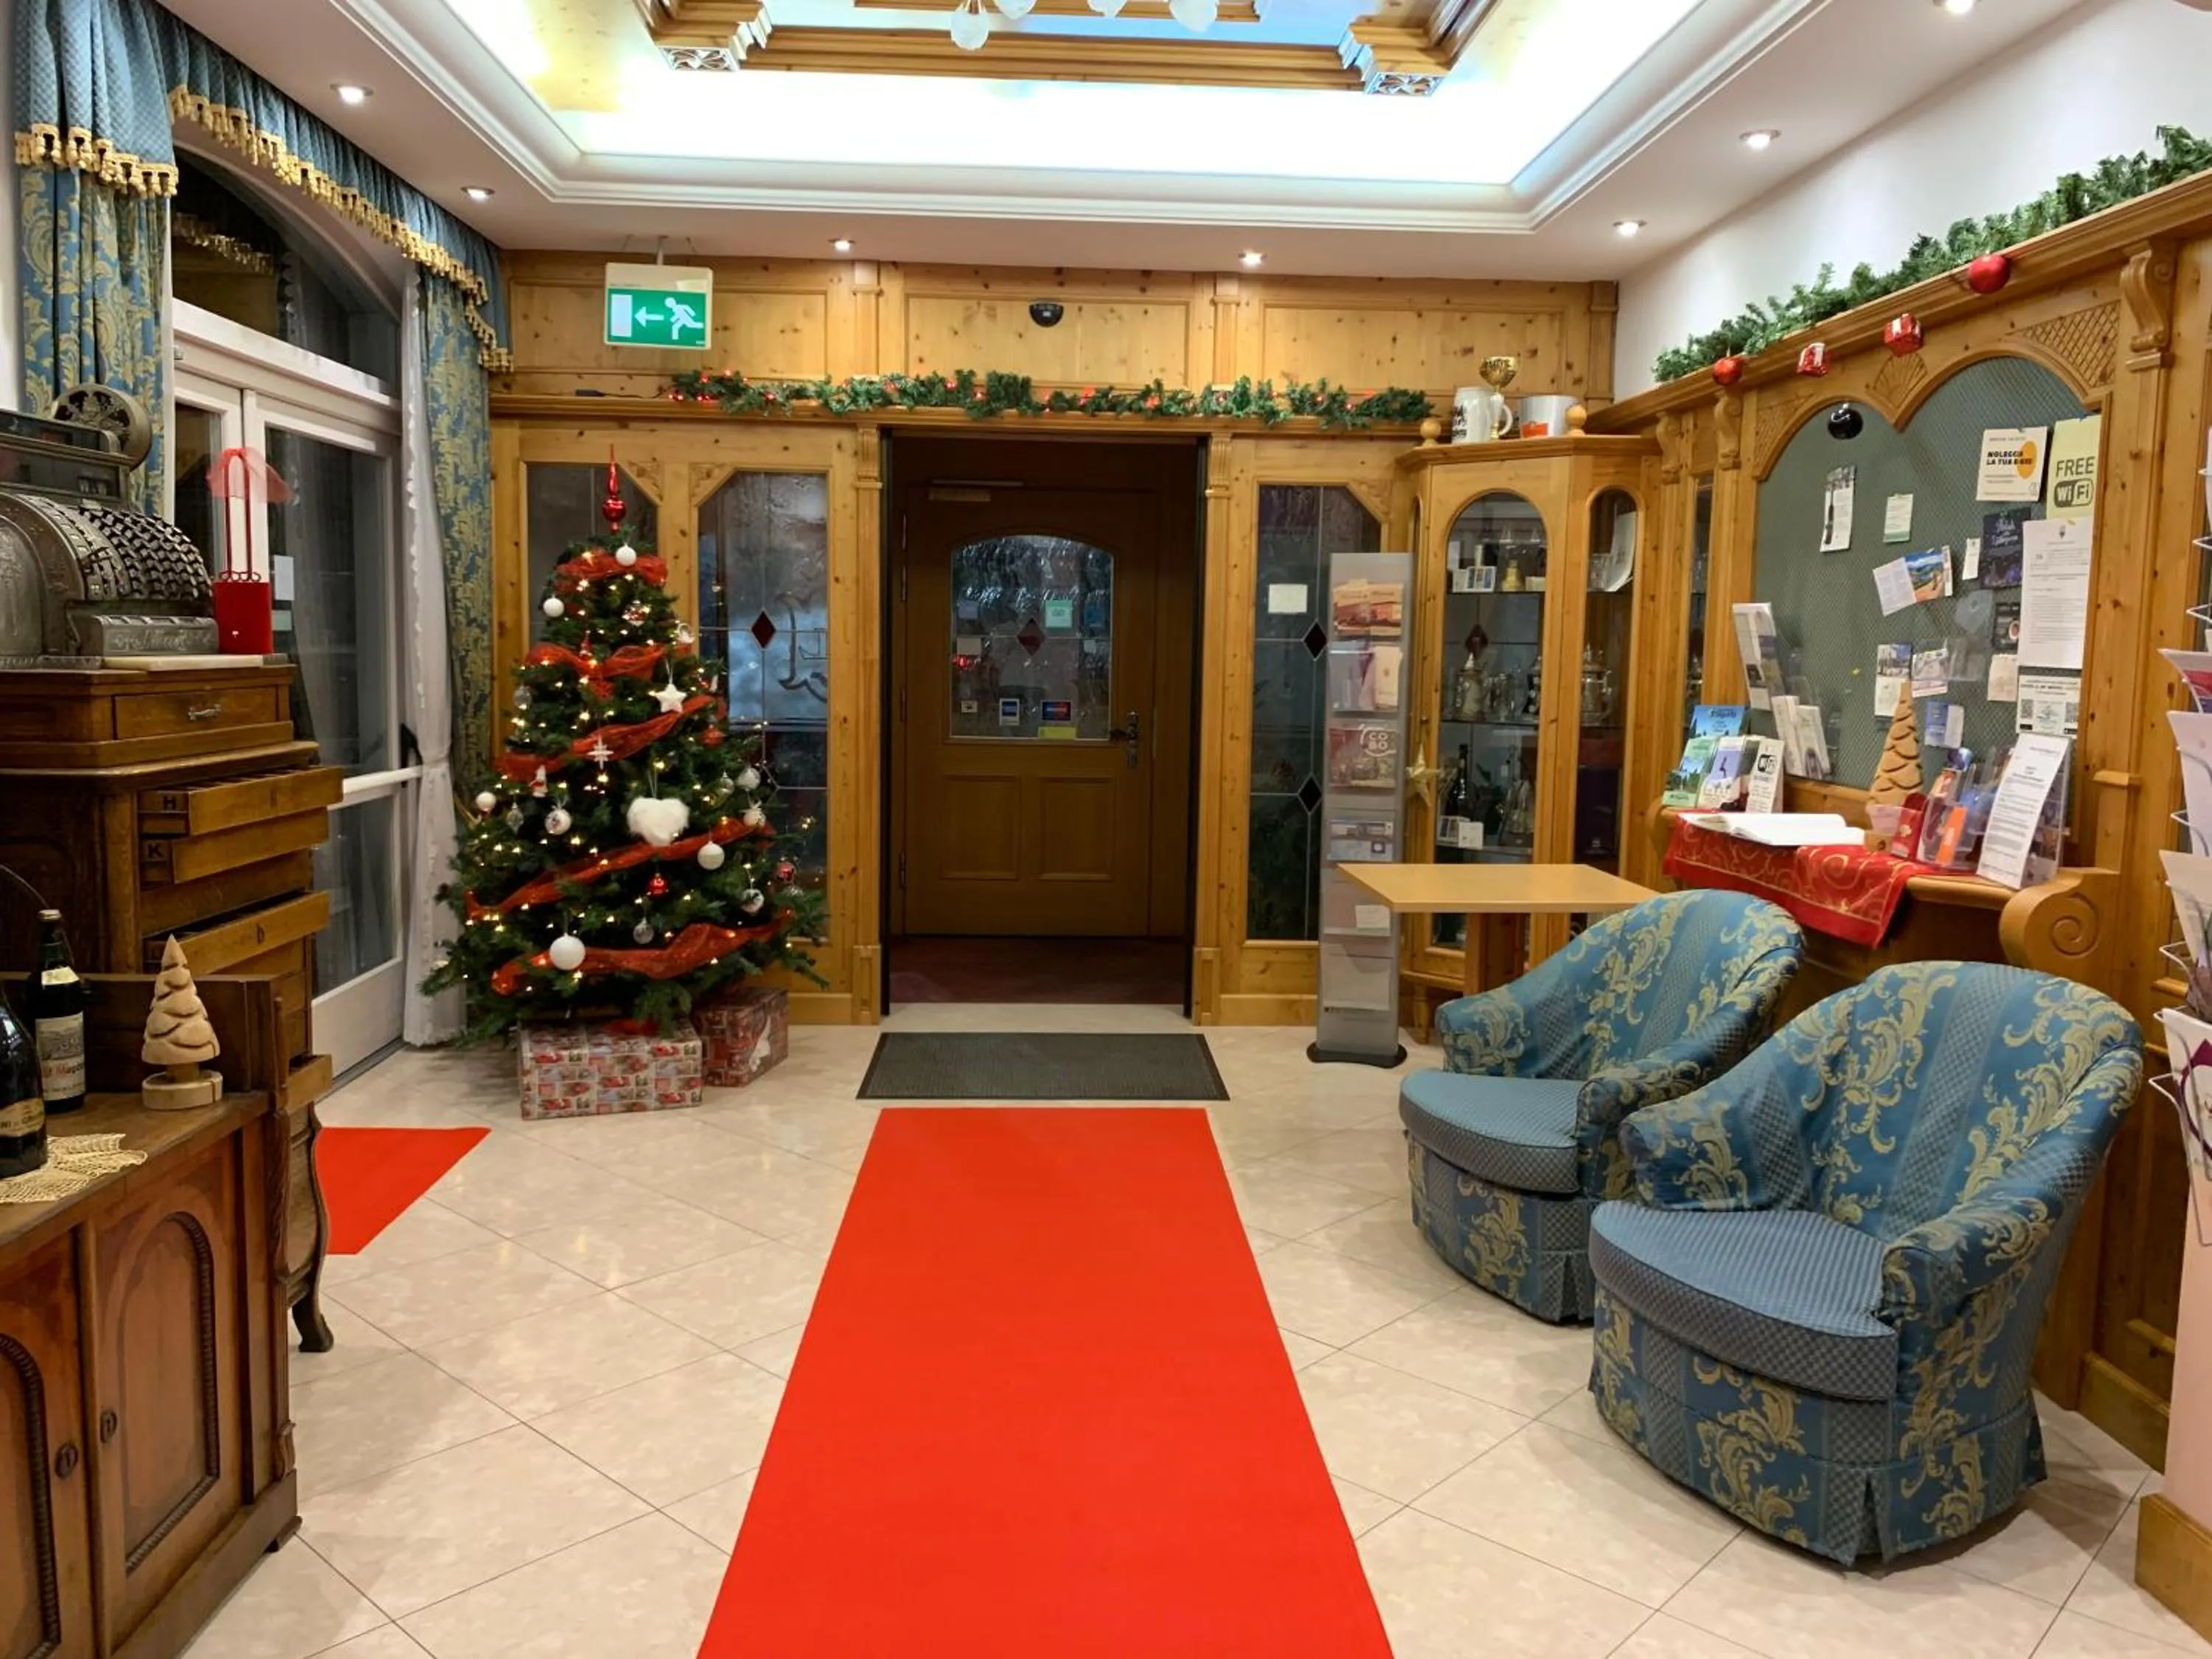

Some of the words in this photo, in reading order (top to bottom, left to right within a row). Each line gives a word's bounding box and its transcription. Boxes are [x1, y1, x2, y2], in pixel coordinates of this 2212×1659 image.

[2056, 456, 2096, 477] FREE
[164, 796, 176, 810] H
[148, 844, 162, 856] K
